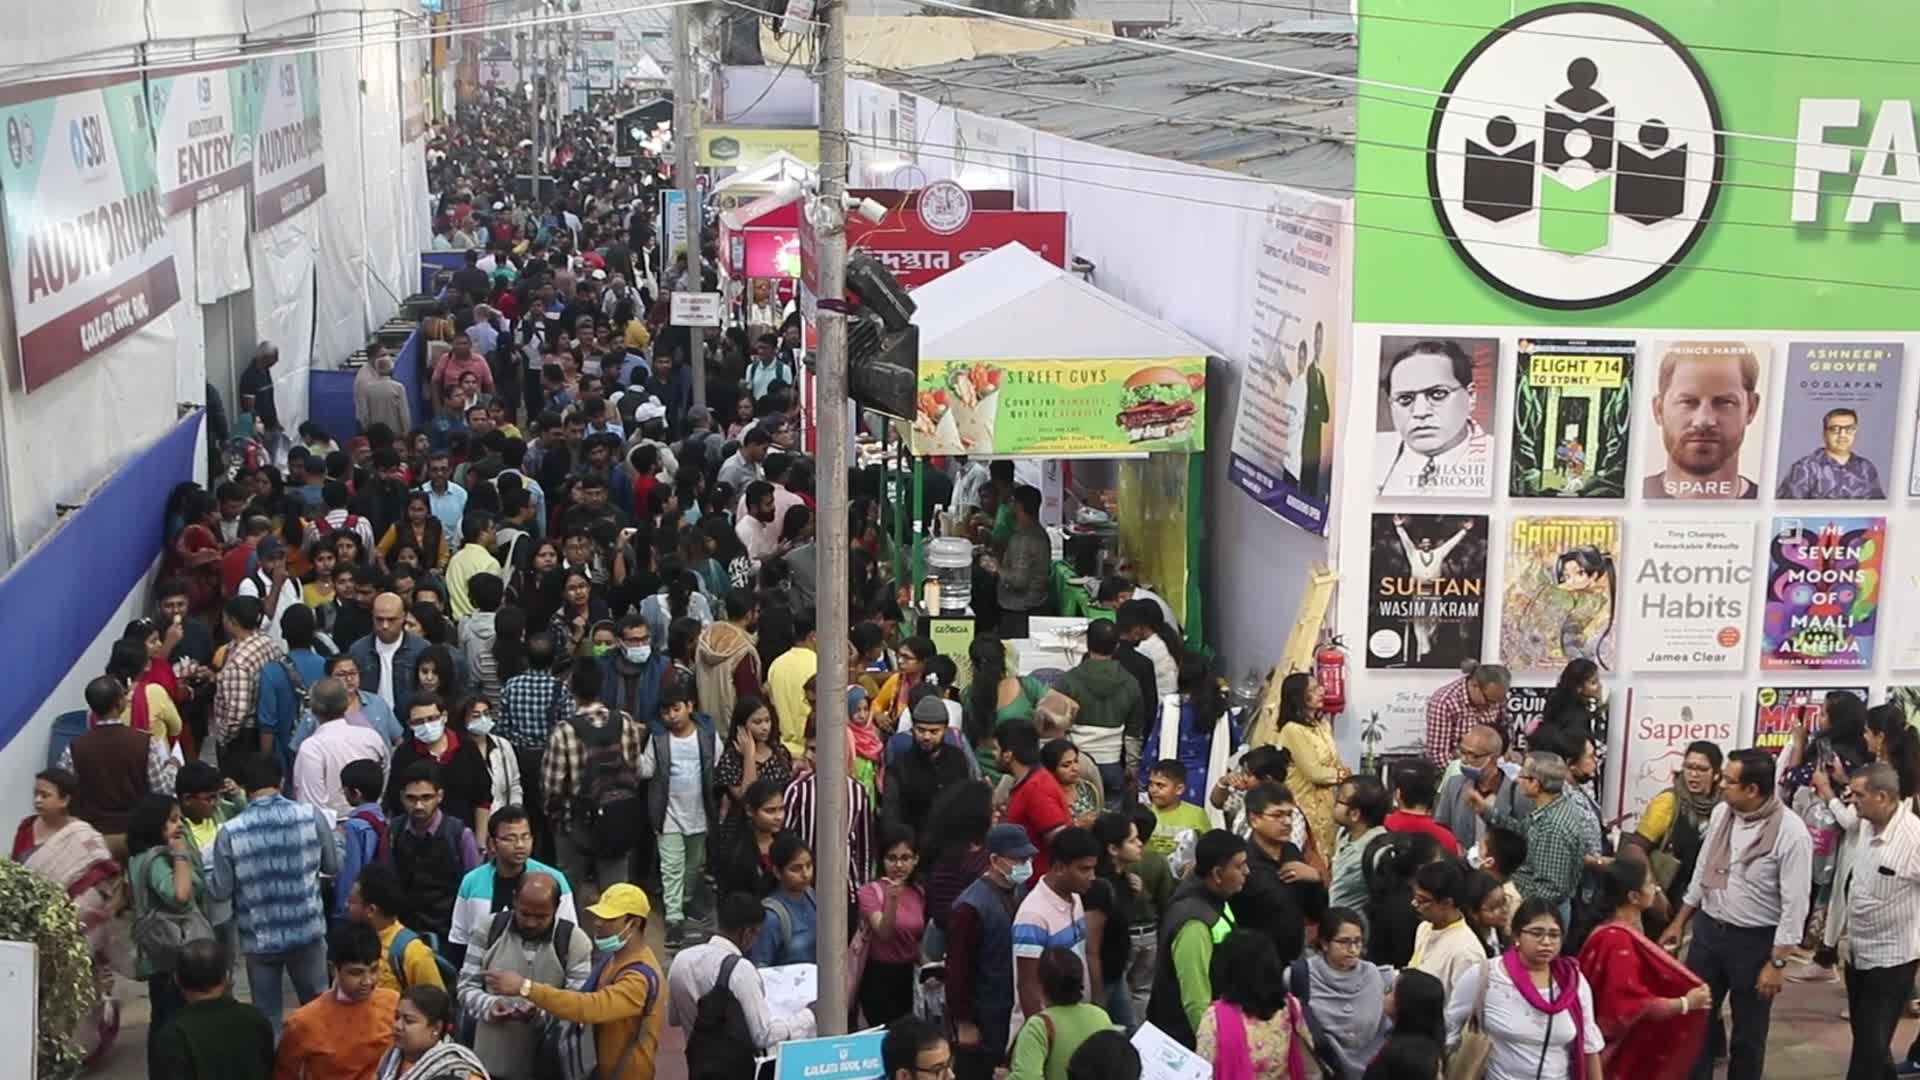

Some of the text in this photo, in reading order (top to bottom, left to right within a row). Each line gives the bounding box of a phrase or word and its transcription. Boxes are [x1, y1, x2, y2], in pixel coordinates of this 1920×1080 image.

[82, 114, 106, 168] SBI
[258, 115, 323, 176] AUDITORIUM
[177, 133, 235, 185] ENTRY
[27, 186, 166, 304] AUDITORIUM
[1807, 349, 1884, 359] ASHNEER
[1532, 358, 1620, 374] FLIGHT 714
[1809, 361, 1877, 372] GROVER
[1007, 369, 1107, 384] STREET GUYS
[1534, 375, 1592, 385] TO SYDNEY
[1431, 463, 1485, 477] HASHI
[1664, 481, 1732, 496] SPARE
[1667, 530, 1685, 539] Tiny
[1817, 525, 1845, 537] THE
[1797, 546, 1861, 560] SEVEN
[1636, 558, 1752, 585] Atomic
[1787, 569, 1866, 584] MOONS
[1379, 576, 1482, 597] SULTAN
[1641, 592, 1743, 619] Habits
[1811, 592, 1839, 605] OF
[1379, 600, 1480, 617] WASIM AKRAM
[935, 623, 969, 634] GEORGIA
[1790, 615, 1855, 629] MAALI
[1778, 640, 1861, 653] ALMEIDA
[1646, 651, 1727, 662] James Clear
[1638, 716, 1731, 747] Sapiens
